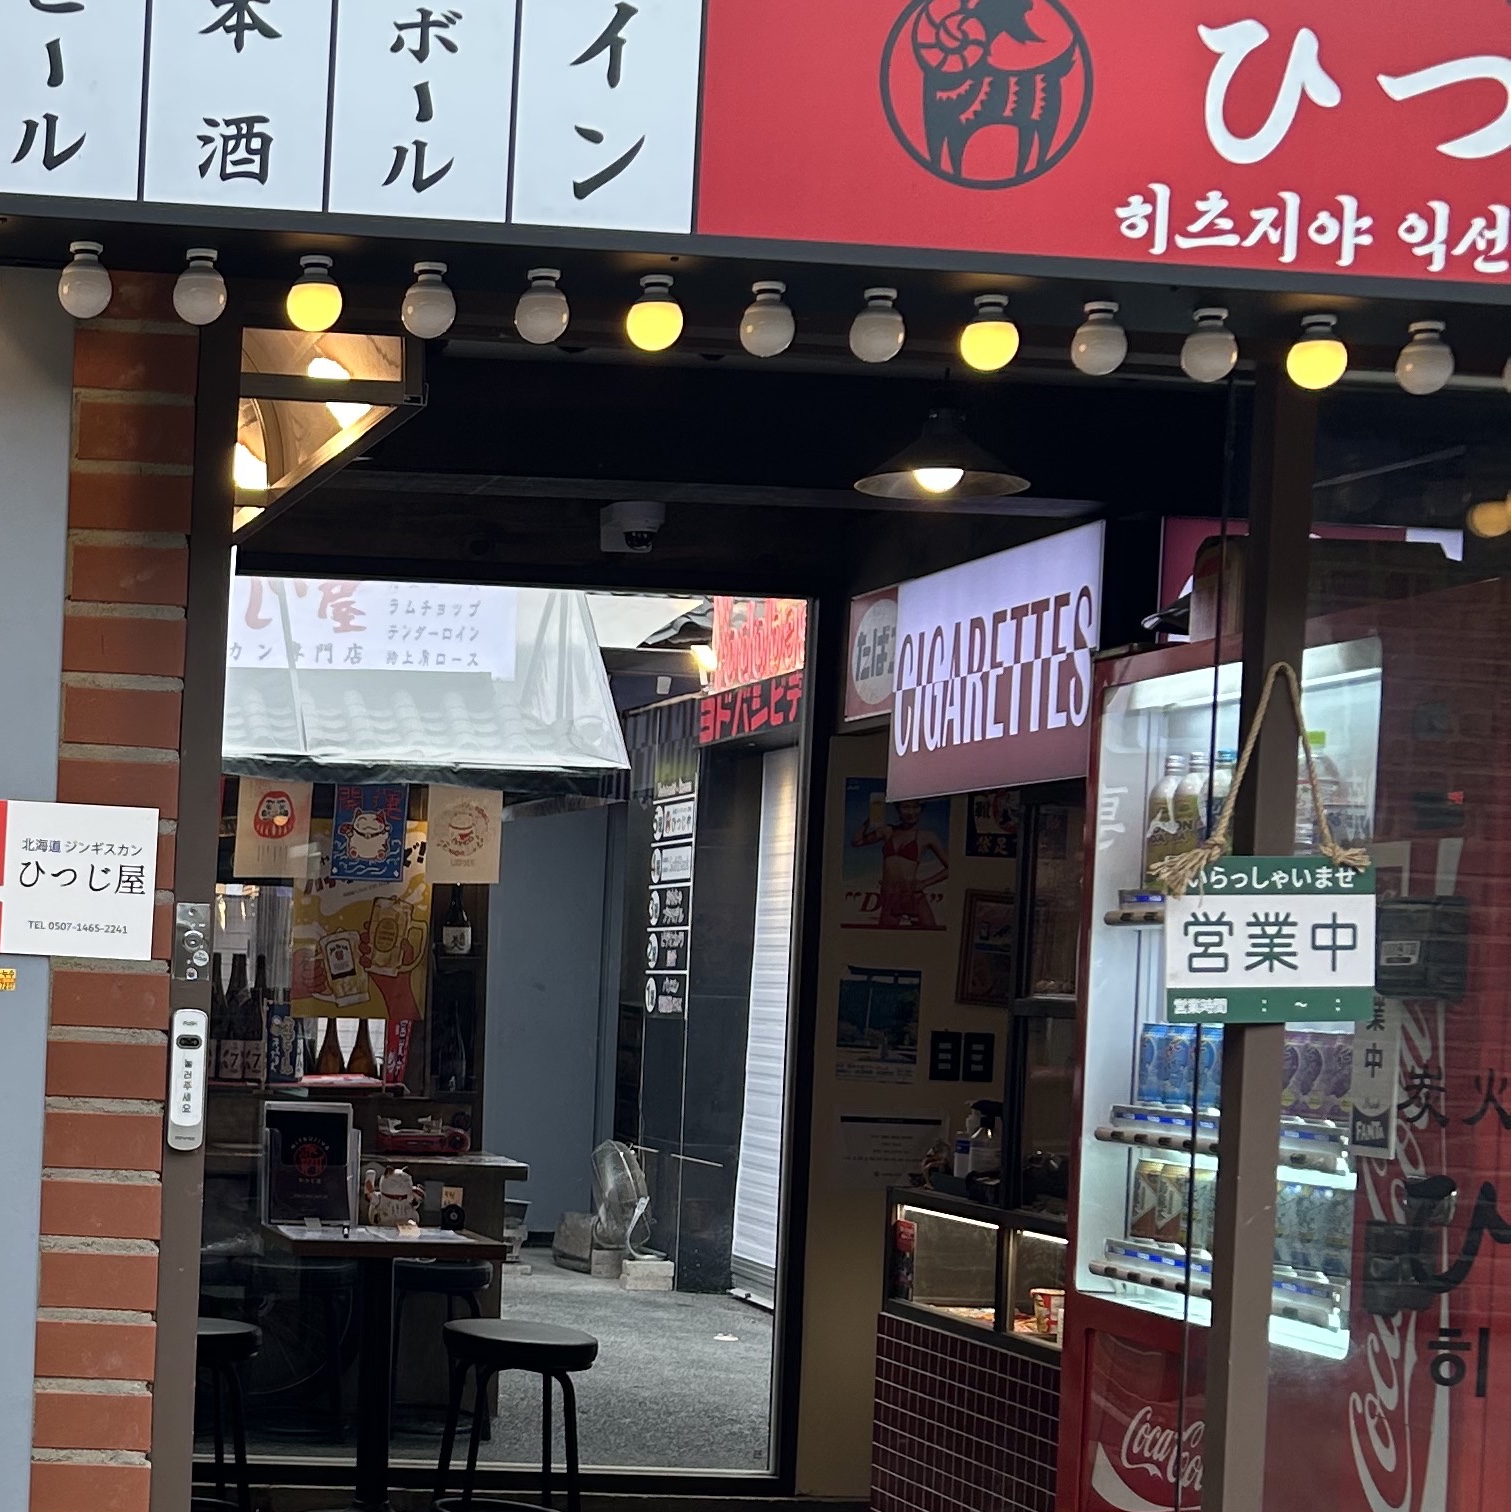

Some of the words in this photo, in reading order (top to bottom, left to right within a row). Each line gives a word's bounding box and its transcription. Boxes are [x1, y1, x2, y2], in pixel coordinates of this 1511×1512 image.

[13, 0, 87, 172] ール
[197, 0, 282, 186] 本酒
[382, 7, 459, 194] ボール
[569, 2, 646, 201] イン
[1196, 18, 1511, 165] ひつ
[1114, 182, 1374, 267] 히츠지야
[1396, 199, 1510, 274] 익선
[893, 585, 1094, 757] CIGARETTES
[18, 860, 147, 896] ひつじ屋
[21, 838, 62, 854] 北海道
[64, 841, 144, 857] ジンギスカン
[1188, 865, 1357, 891] いらっしゃいませ
[28, 920, 46, 931] TEL
[48, 921, 129, 935] 0507-1465-2241
[1182, 910, 1358, 974] 営業中
[1427, 1327, 1491, 1398] 히
